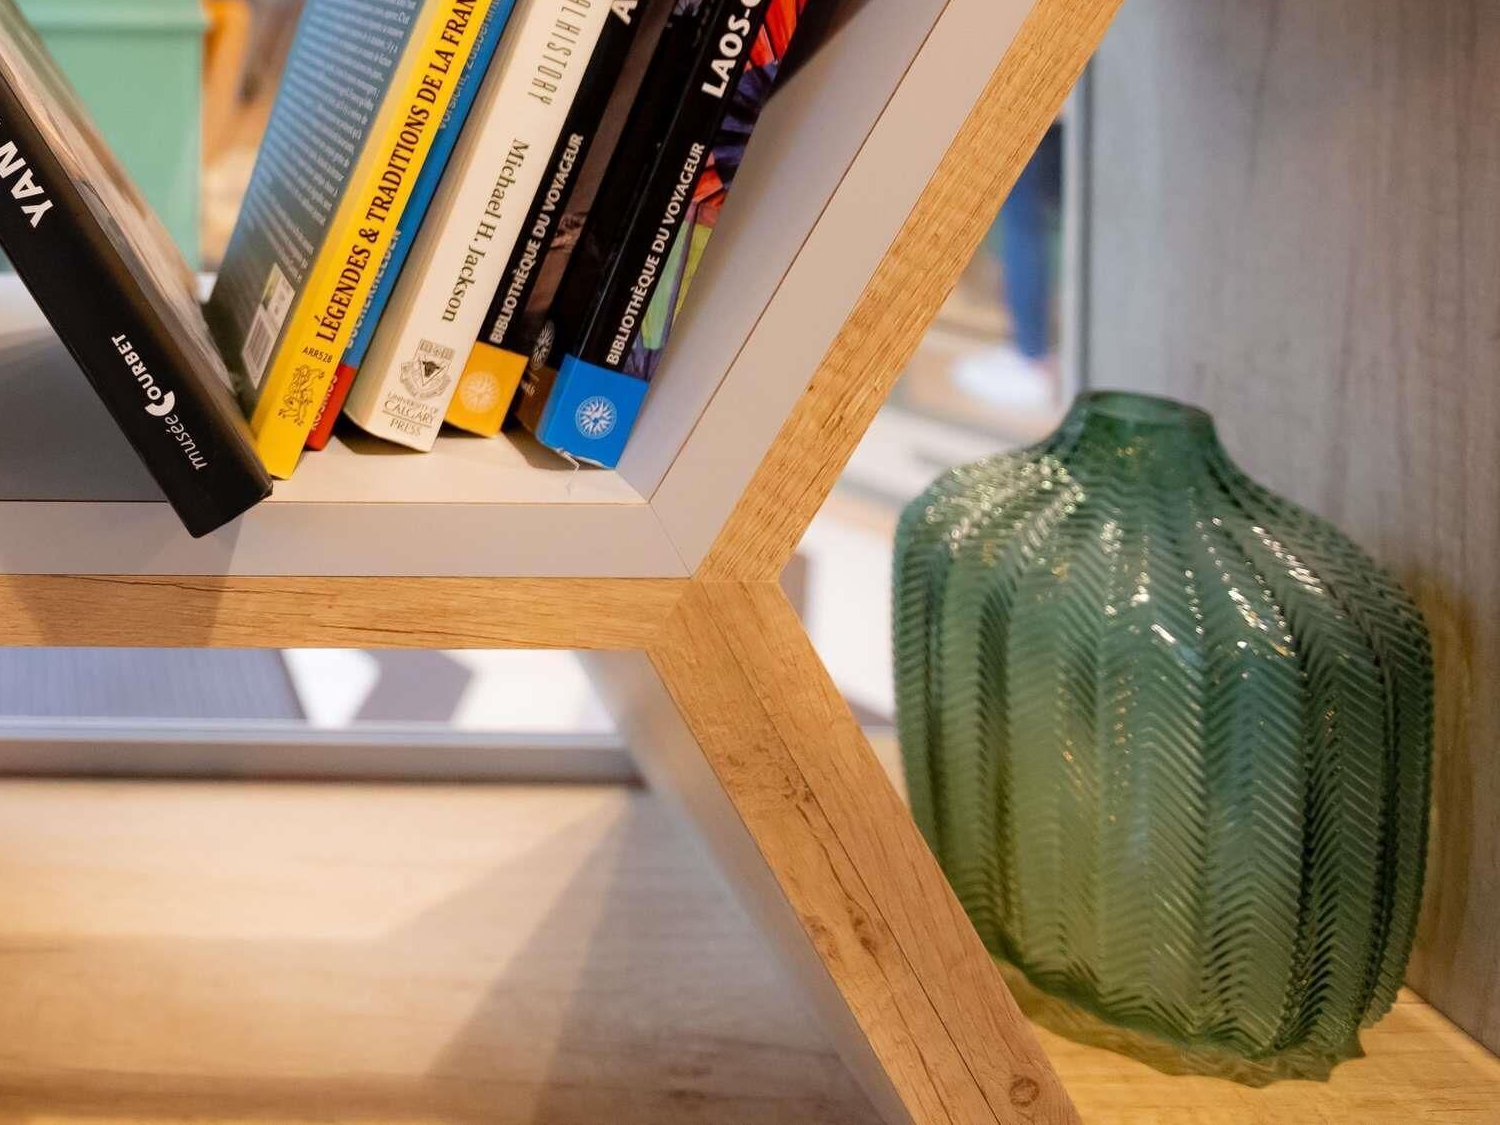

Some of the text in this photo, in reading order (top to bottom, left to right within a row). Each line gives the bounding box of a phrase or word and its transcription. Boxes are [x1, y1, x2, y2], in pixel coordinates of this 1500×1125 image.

[416, 74, 443, 105] DE
[429, 48, 456, 75] LA
[528, 18, 581, 105] HISTORY
[366, 104, 430, 224] TRADITIONS
[359, 226, 380, 244] &
[442, 138, 530, 322] Michael H. Jackson
[489, 238, 542, 344] BIBLIOTHÈQUE
[532, 212, 550, 238] DU
[543, 132, 584, 212] VOYAGEUR
[606, 142, 706, 365] BIBLIOTHÈQUE DU VOYAGEUR
[314, 244, 372, 343] LÉGENDES
[111, 333, 208, 470] musée COURBET
[384, 399, 437, 424] CALGARY
[389, 418, 422, 436] PRESS
